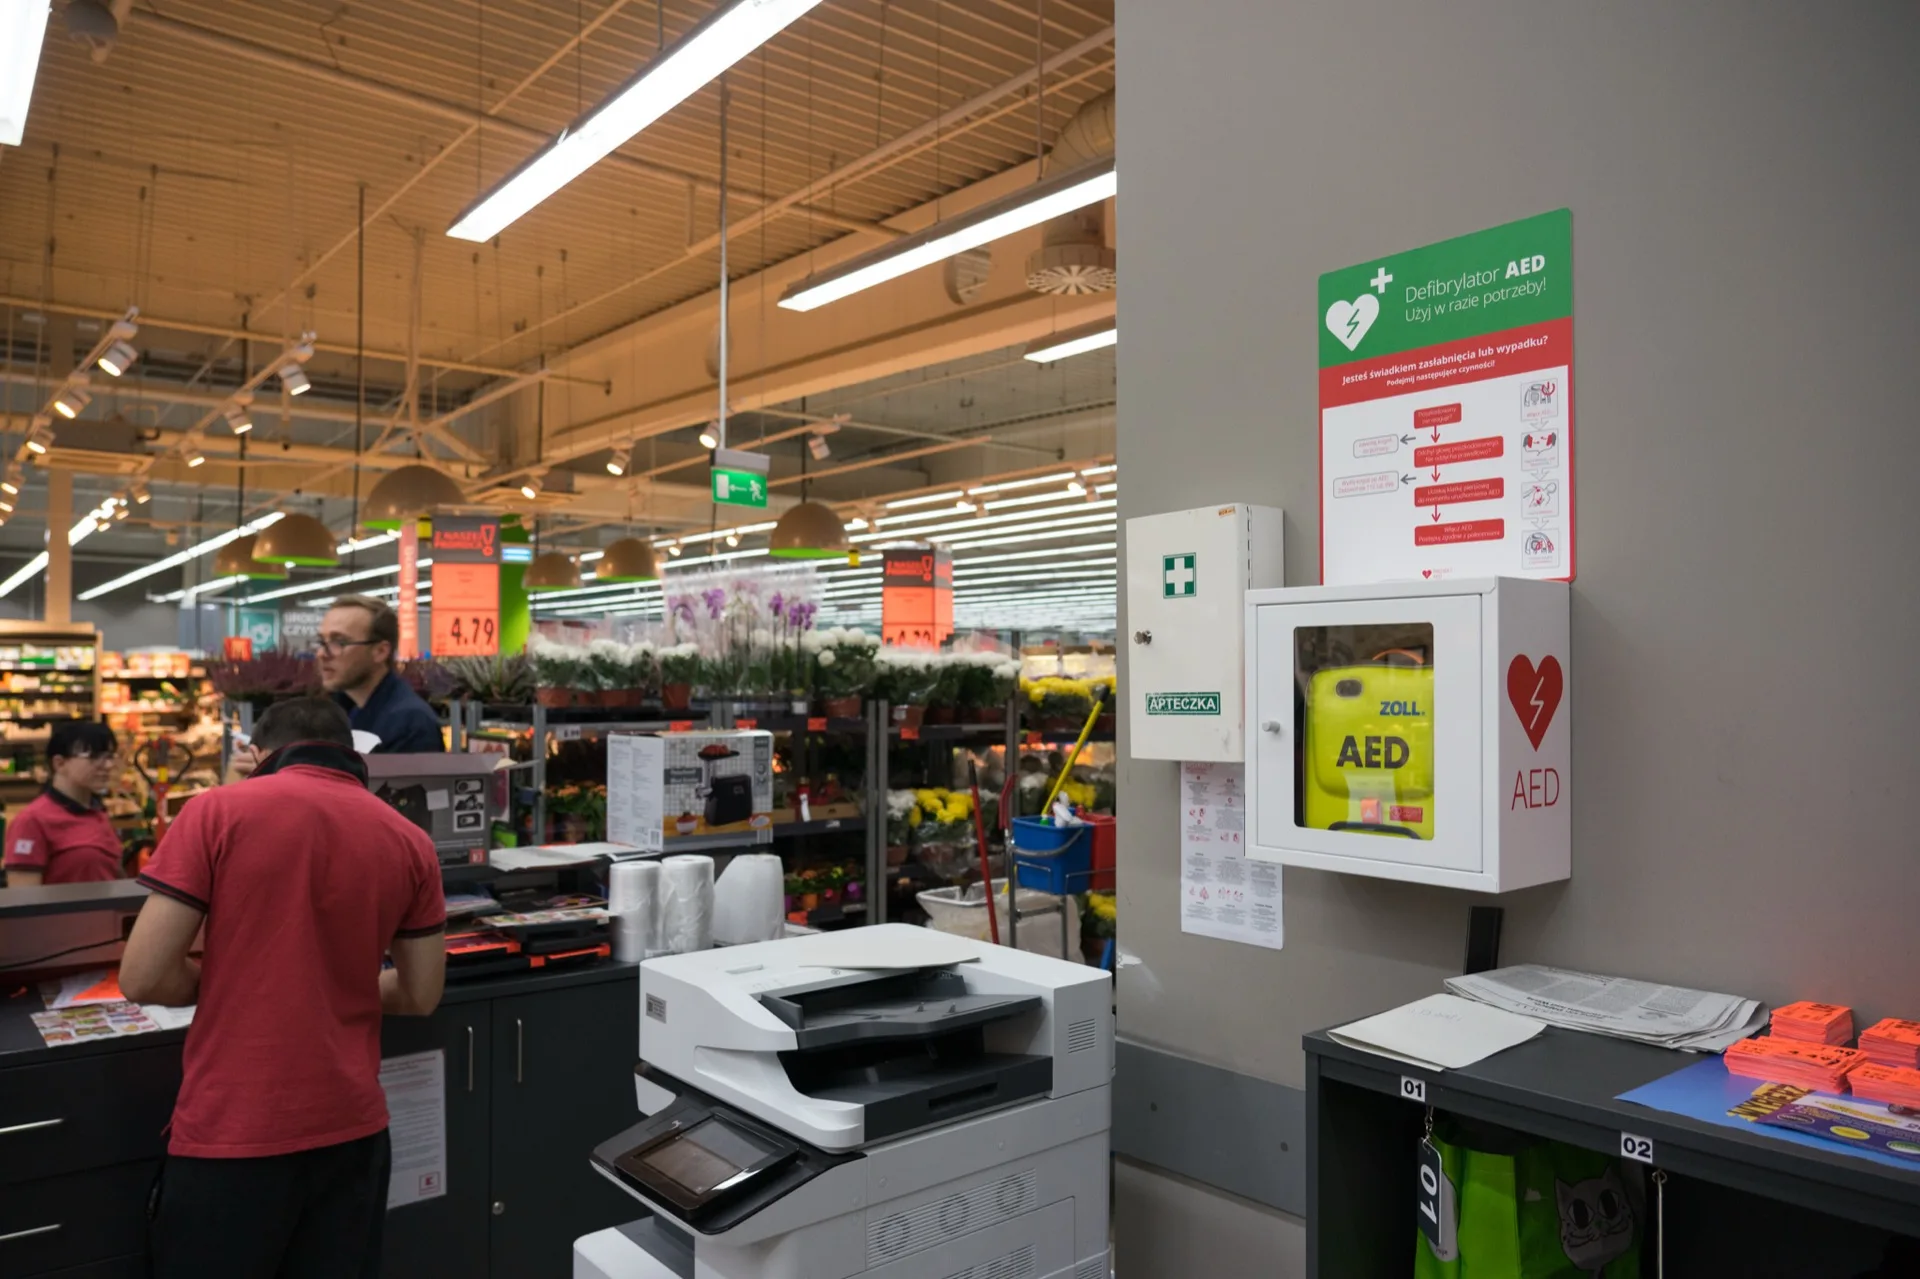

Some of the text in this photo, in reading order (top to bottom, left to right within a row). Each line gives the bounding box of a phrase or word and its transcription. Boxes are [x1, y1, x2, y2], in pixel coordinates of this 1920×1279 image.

[1405, 254, 1546, 303] Defibrylator AED
[1405, 276, 1546, 323] Użyj w razie potrzeby!
[1342, 335, 1548, 386] Jesteś świadkiem zasłabnięcia lub wypadku?
[1386, 359, 1496, 387] Podejmij następujące czynności!
[450, 616, 495, 646] 4.79
[1149, 697, 1217, 711] APTECZKA
[1335, 735, 1410, 769] AED
[1510, 768, 1560, 811] AED
[1403, 1079, 1424, 1098] 01
[1623, 1137, 1652, 1159] 02
[1419, 1163, 1438, 1225] 01
